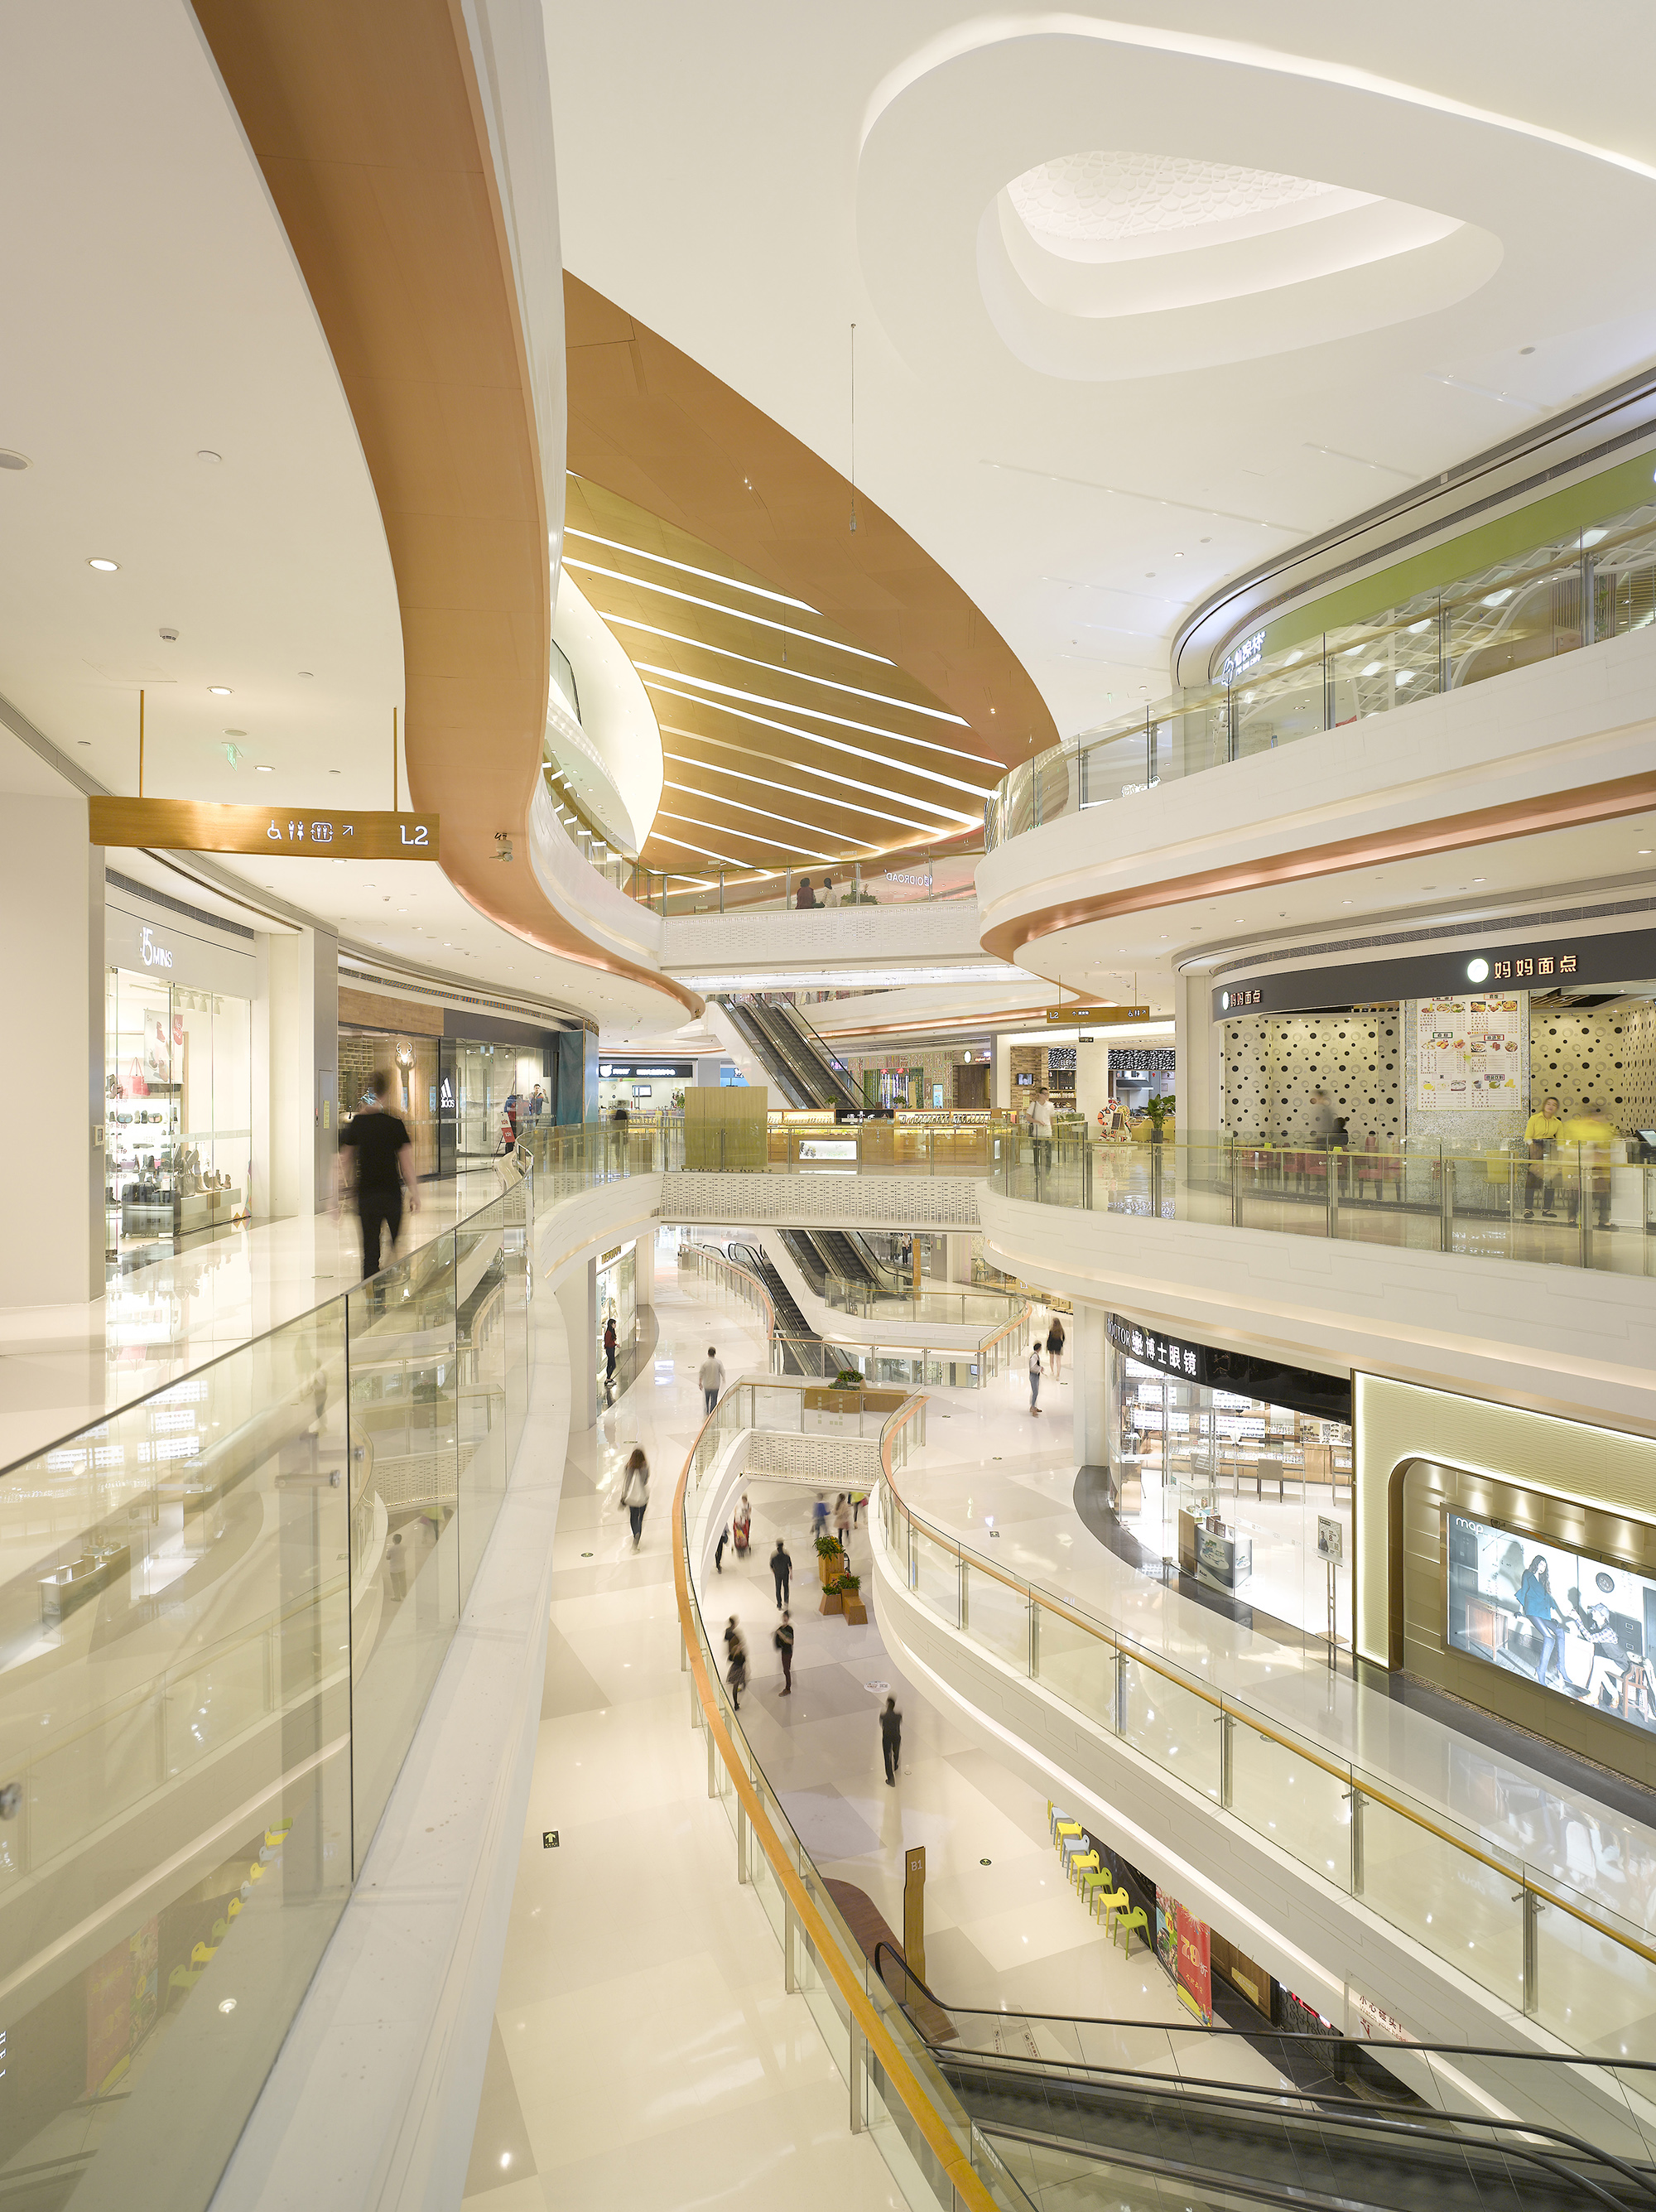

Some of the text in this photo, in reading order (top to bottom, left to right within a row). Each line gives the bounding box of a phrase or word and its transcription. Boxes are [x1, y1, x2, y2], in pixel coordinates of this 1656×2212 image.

[399, 825, 429, 846] L2
[1494, 955, 1577, 979] 妈妈面点
[1230, 990, 1260, 1007] 妈妈面点
[1049, 1011, 1059, 1019] L2
[1146, 1336, 1197, 1376] 博士眼镜
[1456, 1516, 1484, 1535] map
[911, 1859, 923, 1872] B1
[1378, 2020, 1392, 2032] your
